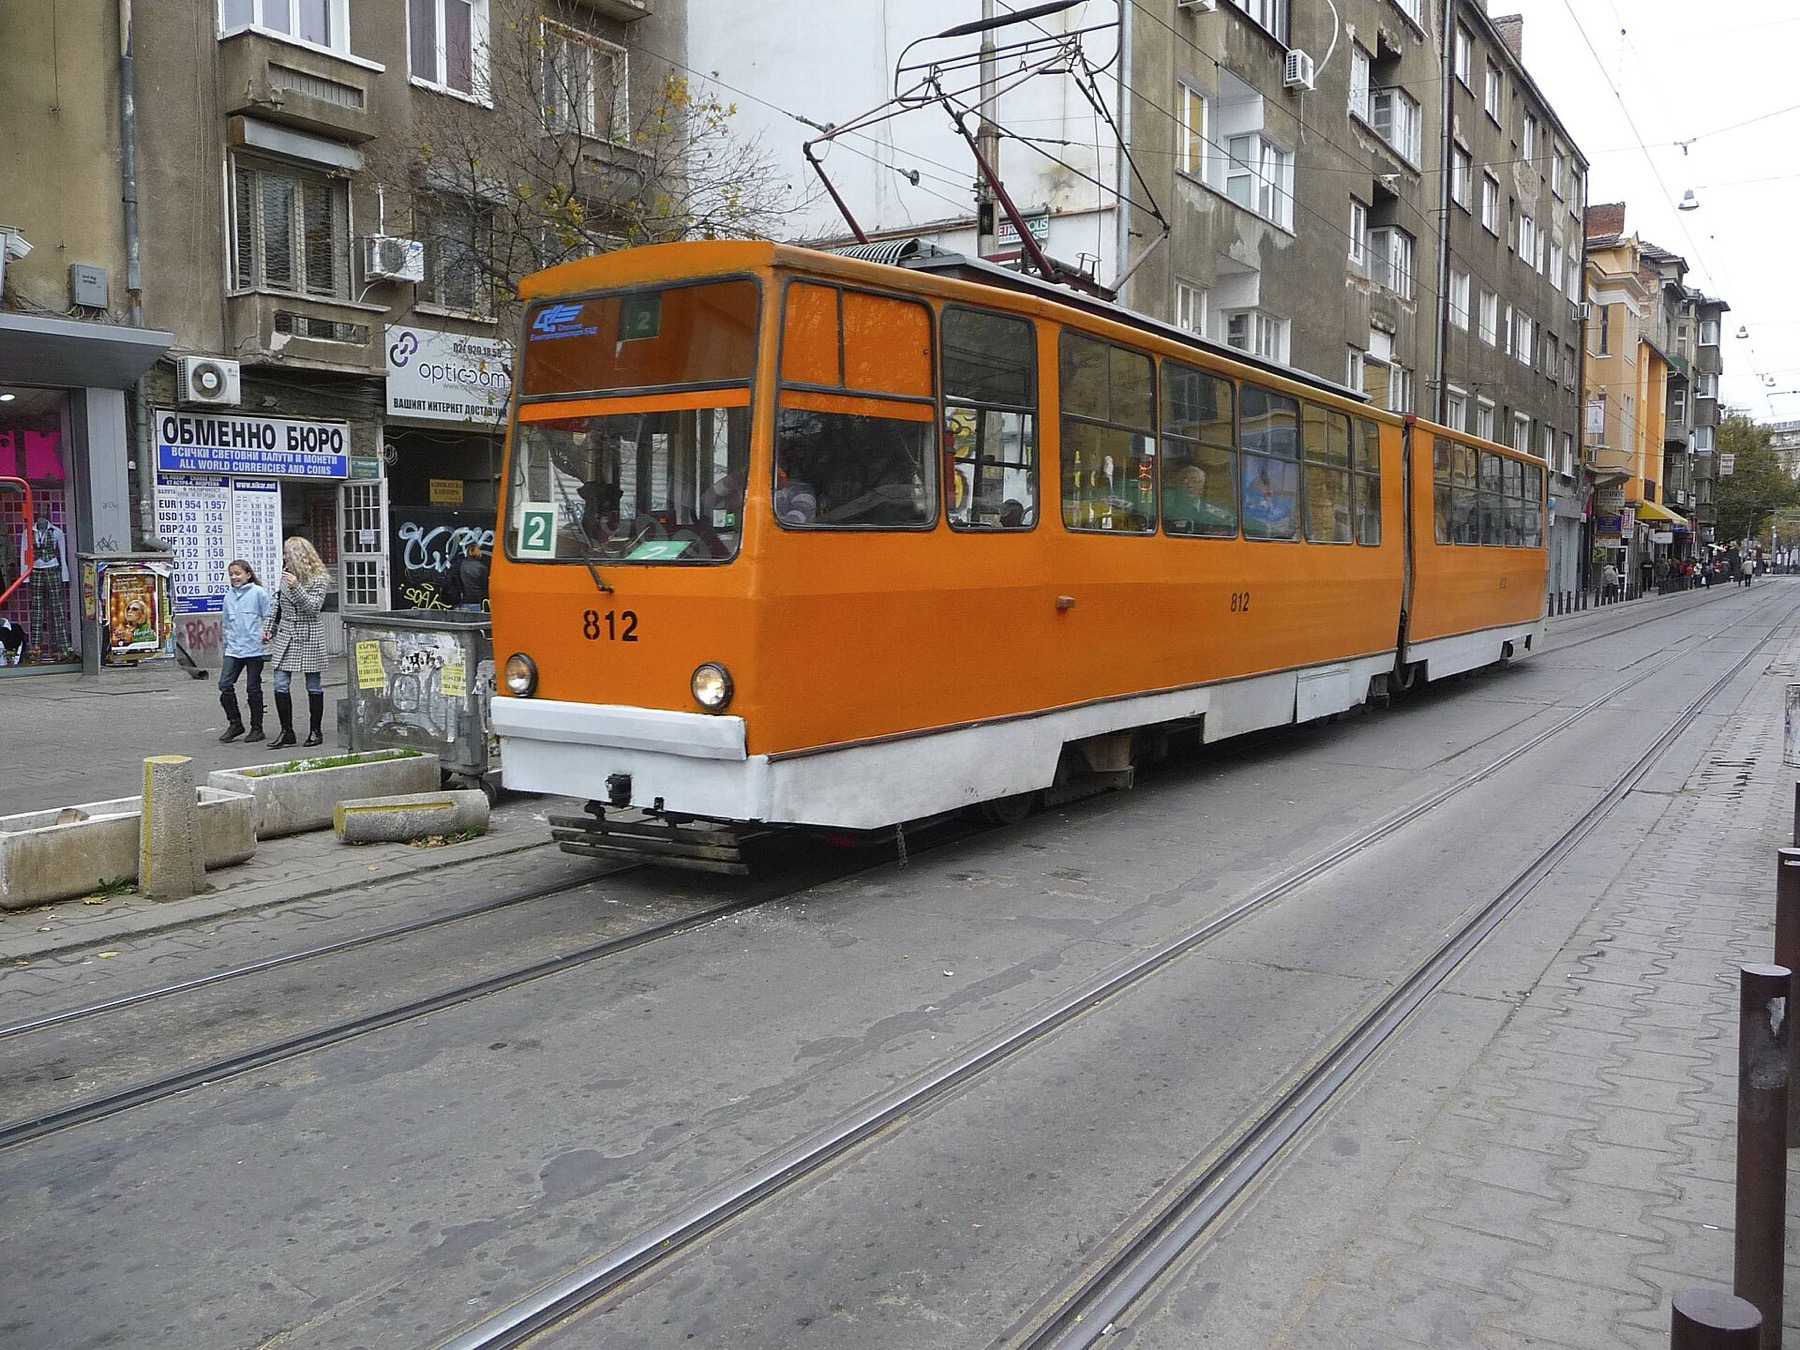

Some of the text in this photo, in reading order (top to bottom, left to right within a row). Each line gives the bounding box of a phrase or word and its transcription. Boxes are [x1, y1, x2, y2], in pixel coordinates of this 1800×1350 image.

[638, 311, 650, 330] 2
[393, 398, 426, 411] ВАШИЯТ
[428, 400, 463, 414] ИНТЕРНЕТ
[162, 416, 343, 454] ОБМЕННО БЮРО
[171, 446, 338, 465] ВСИЧКИ СВЕТОВНИ ВАЛУТИ И МОНЕТИ
[179, 459, 332, 475] ALL WORLD CURRENCIES AND COINS
[159, 499, 177, 509] EUR
[159, 512, 178, 521] USD
[160, 524, 178, 533] GBP
[528, 515, 546, 547] 2
[1230, 591, 1250, 612] 812
[583, 610, 638, 641] 812
